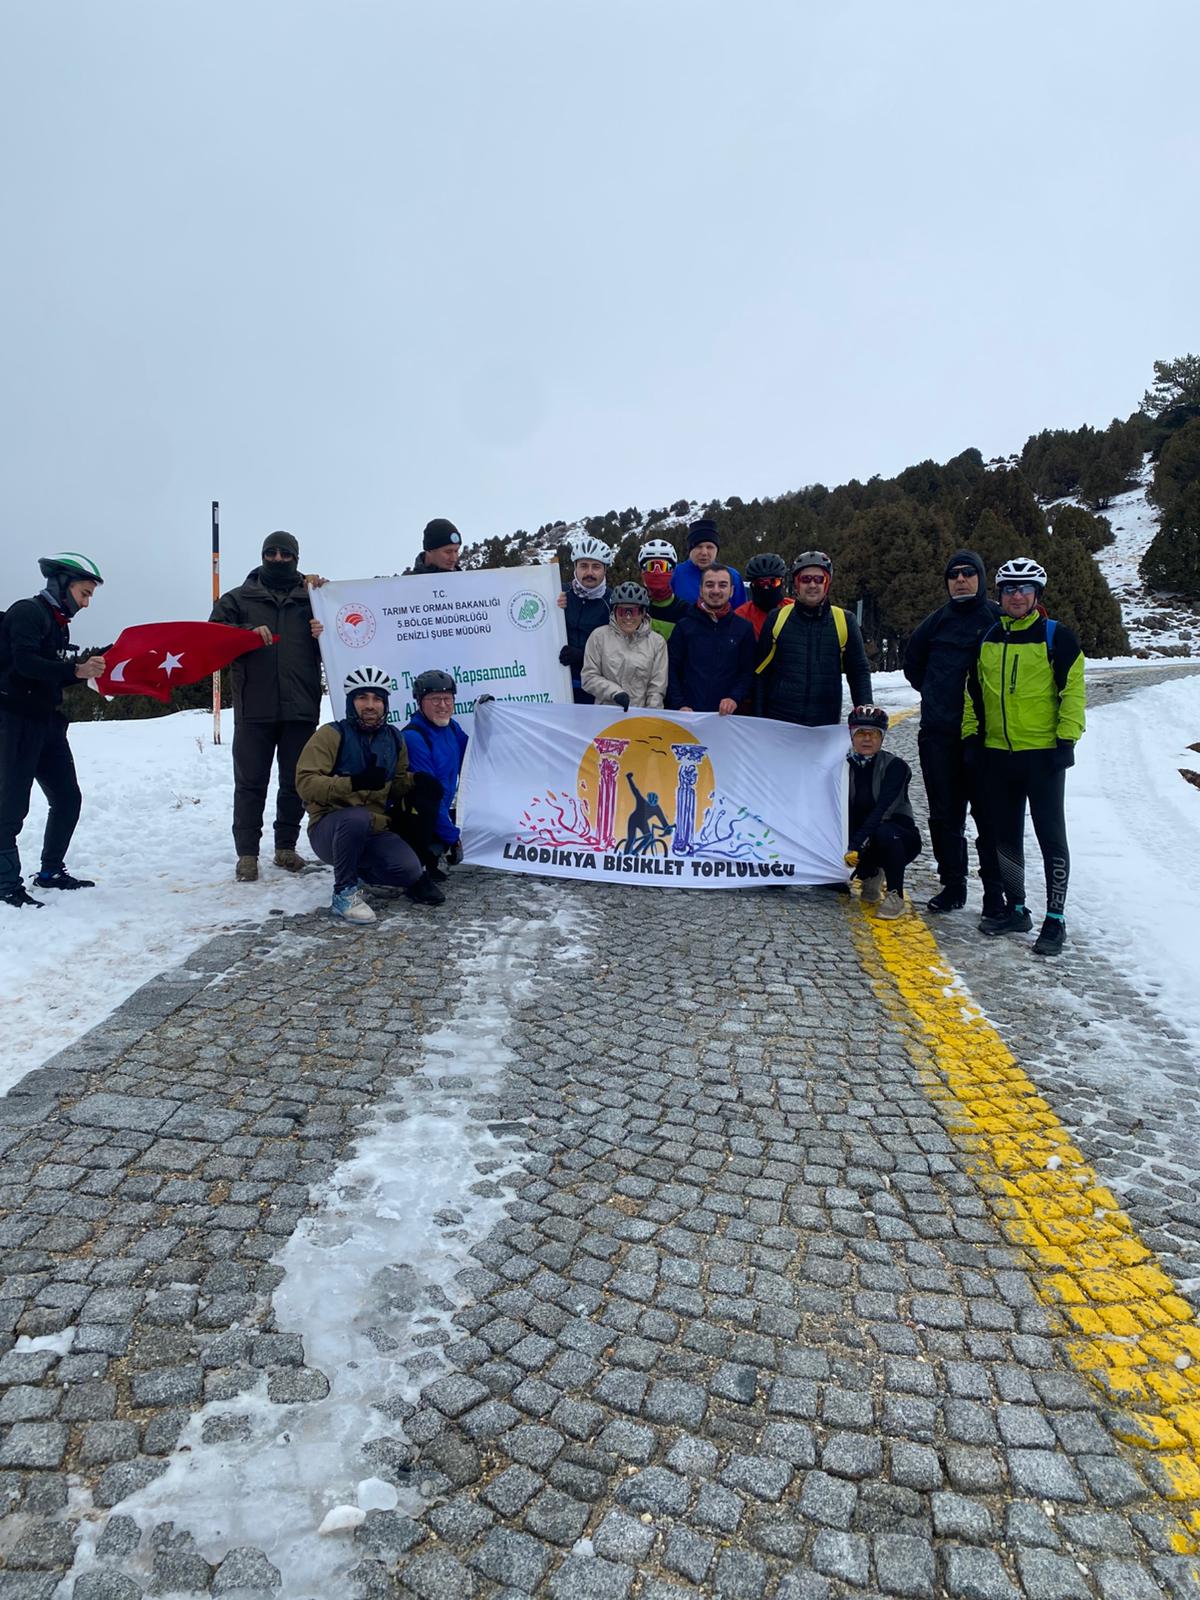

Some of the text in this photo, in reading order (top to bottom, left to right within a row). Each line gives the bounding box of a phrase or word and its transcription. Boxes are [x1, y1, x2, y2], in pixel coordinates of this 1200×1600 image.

[433, 590, 447, 599] T.C.
[382, 598, 501, 616] TARIM VE ORMAN BAKANLIĞI
[397, 612, 489, 628] 5.BÖLGE MÜDÜRLÜĞÜ
[397, 625, 491, 641] DENİZLİ ŞUBE MÜDÜRÜ
[453, 660, 526, 686] Kapsamında
[503, 843, 795, 878] LAODİKYA BİSİKLET TOPLULUĞU
[1050, 857, 1067, 911] PEIKOU
